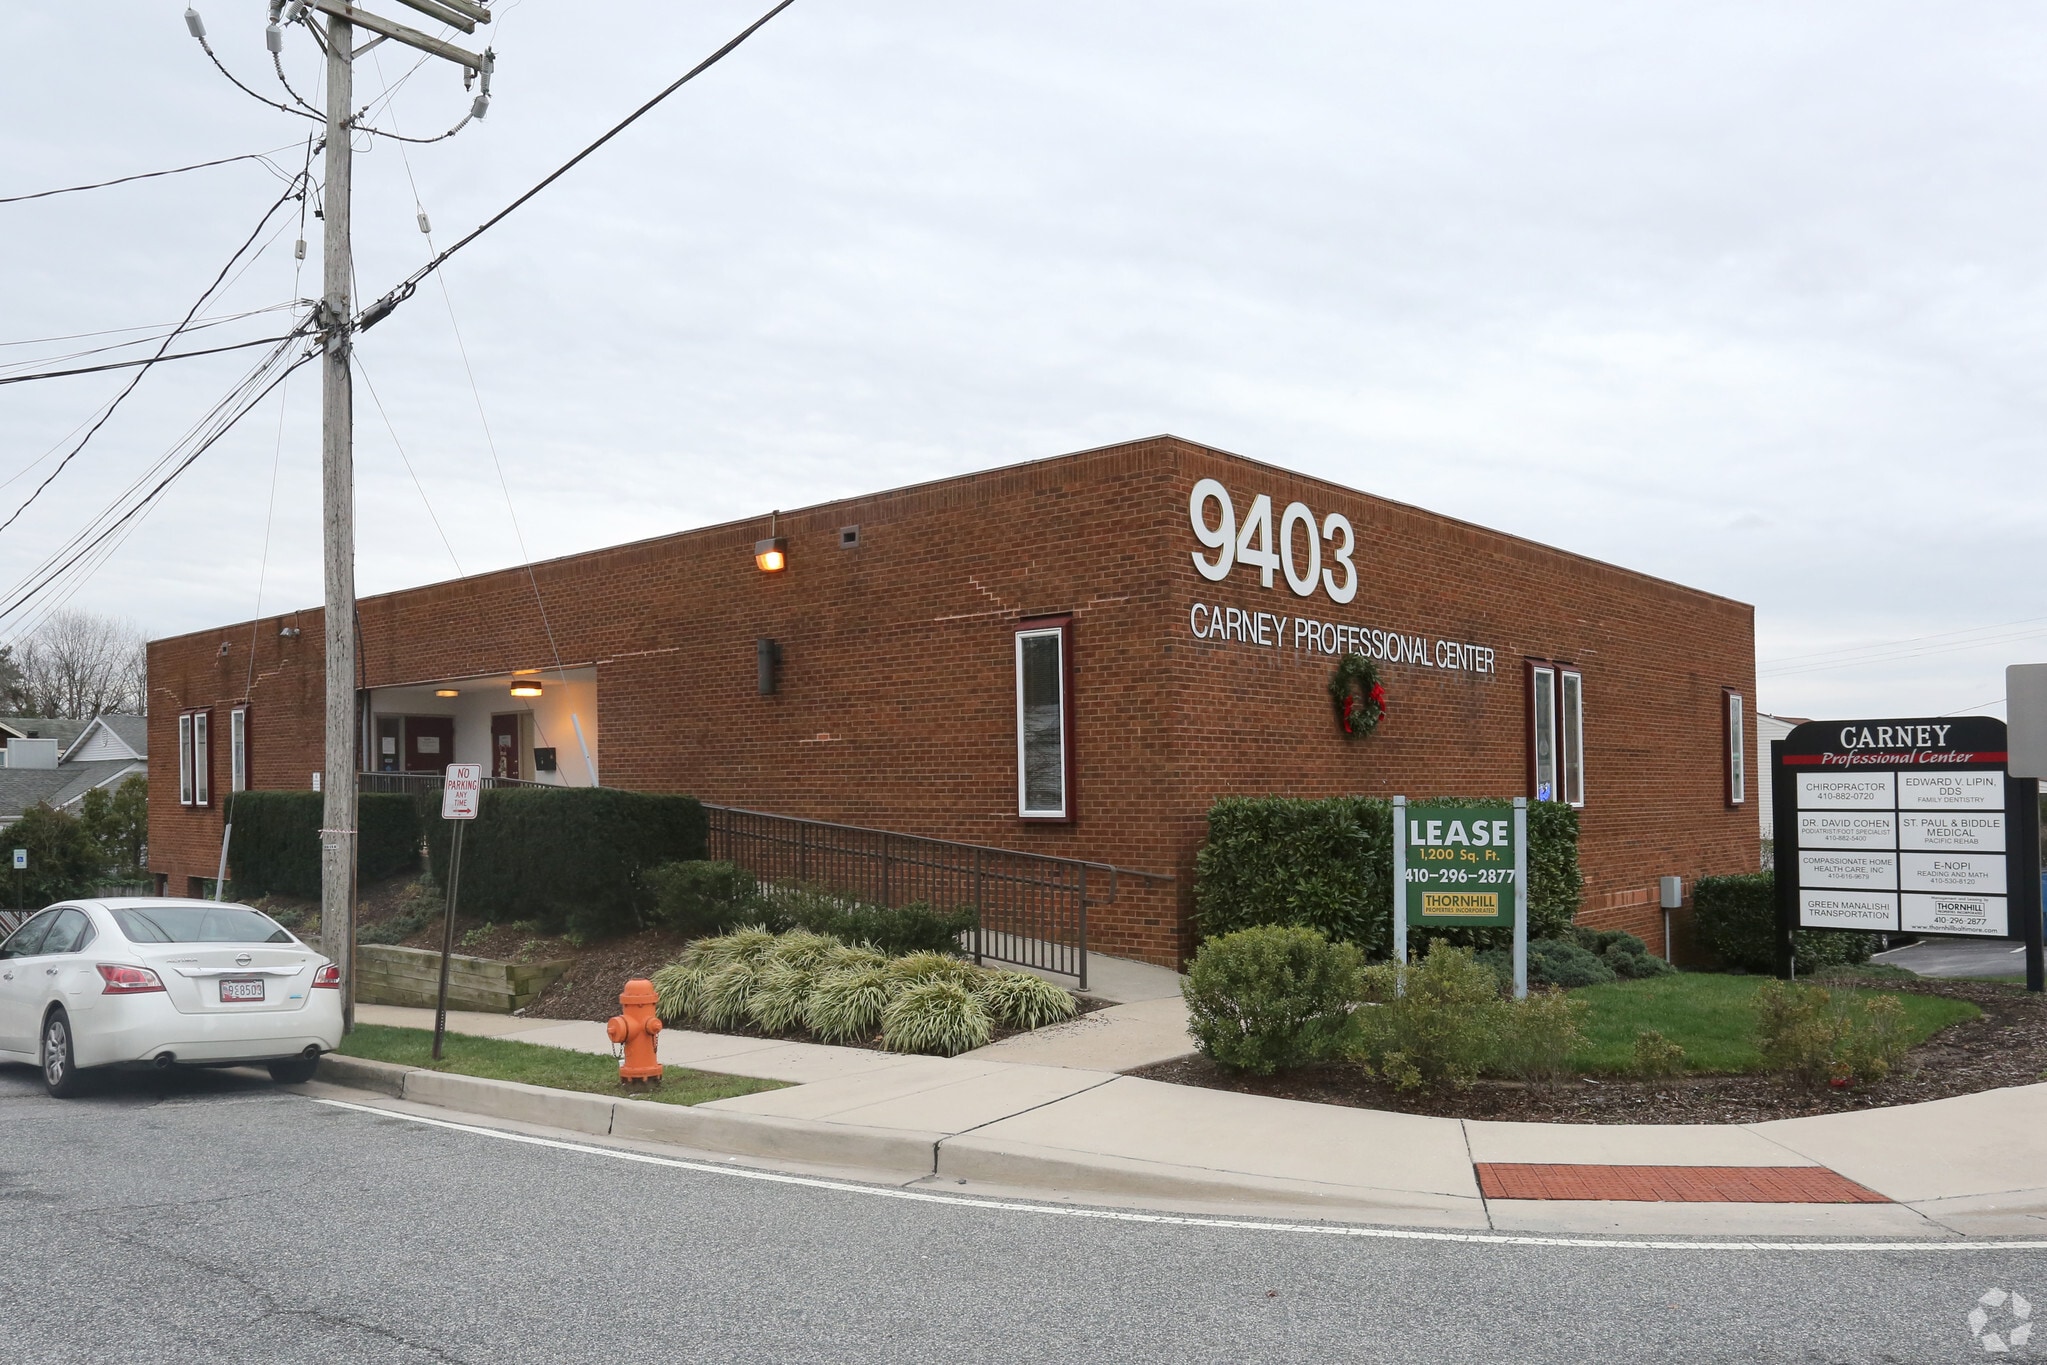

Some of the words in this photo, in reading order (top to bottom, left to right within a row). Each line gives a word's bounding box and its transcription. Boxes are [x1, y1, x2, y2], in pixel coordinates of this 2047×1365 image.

[1189, 478, 1358, 604] 9403
[1190, 602, 1288, 648] CARNEY
[1294, 617, 1434, 667] PROFESSIONAL
[1435, 639, 1495, 674] CENTER
[1840, 725, 1951, 748] CARNEY
[1821, 749, 1917, 768] Professional
[1918, 750, 1973, 764] Center
[457, 768, 470, 778] NO
[447, 780, 477, 790] PARKING
[1806, 783, 1886, 791] CHIROPRACTOR
[1905, 778, 1952, 786] EDWARD
[1955, 778, 1964, 786] V.
[1966, 778, 1997, 787] LIPIN,
[1817, 792, 1875, 800] 410-882-0720
[1939, 787, 1962, 796] DDS
[1802, 819, 1819, 827] DR.
[1821, 819, 1851, 828] DAVID
[1853, 819, 1890, 828] COHEN
[1903, 819, 1919, 827] ST.
[1921, 819, 1948, 828] PAUL
[1950, 819, 1958, 828] &
[1960, 819, 2001, 828] BIDDLE
[1410, 820, 1508, 846] LEASE
[1926, 828, 1975, 837] MEDICAL
[1419, 848, 1454, 861] 1,200
[1460, 849, 1480, 863] Sq.
[1485, 850, 1501, 860] Ft.
[1803, 857, 1867, 865] COMPASSIONATE
[1934, 861, 1971, 870] E-NOPI
[1813, 865, 1843, 873] HEALTH
[1870, 866, 1884, 874] INC
[1405, 868, 1515, 883] 410-296-2877
[1425, 895, 1495, 907] THORNHILL
[1807, 900, 1839, 909] GREEN
[1841, 902, 1890, 911] MANALISHI
[1937, 903, 1983, 912] THORNHILL
[1808, 909, 1890, 920] TRANSPORTATION
